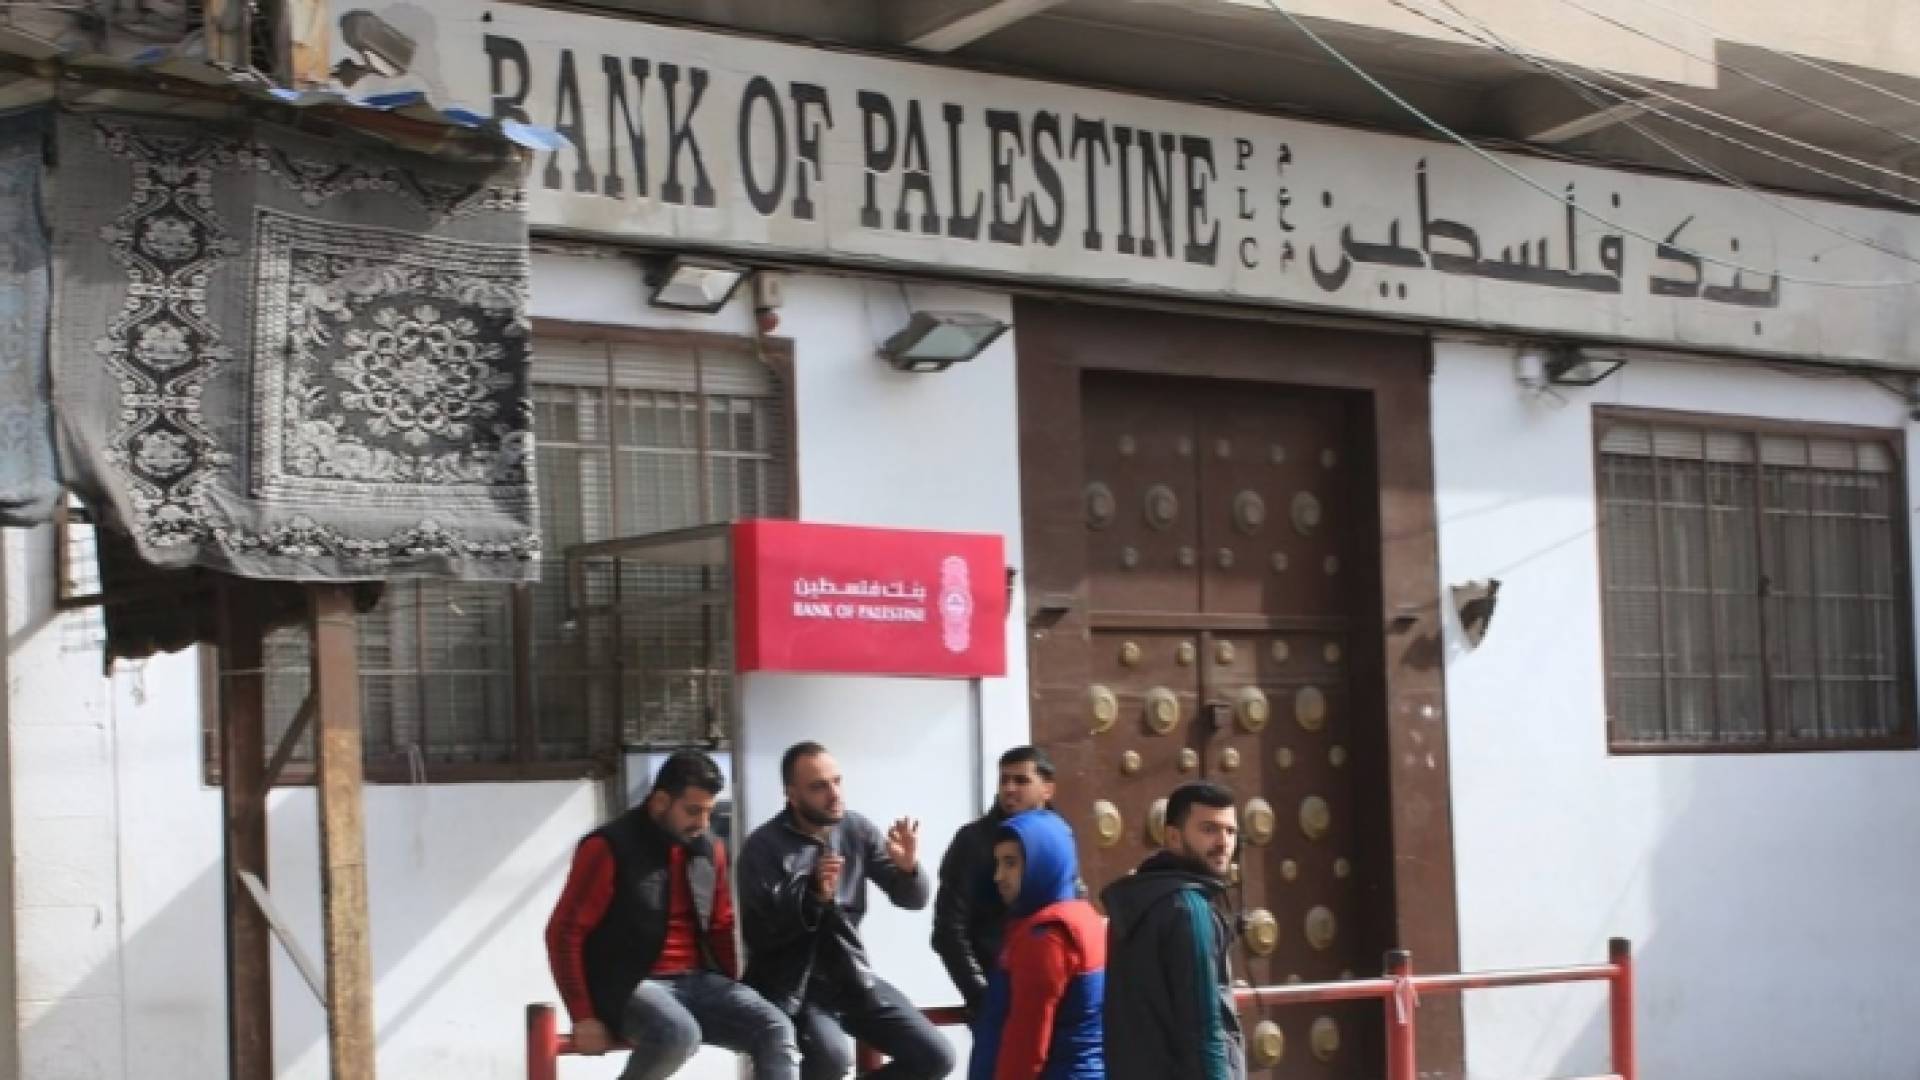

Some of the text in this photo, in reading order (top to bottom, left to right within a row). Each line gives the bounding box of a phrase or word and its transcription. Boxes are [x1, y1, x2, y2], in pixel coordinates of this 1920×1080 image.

[483, 33, 1221, 266] BANK OF PALESTINE
[1648, 215, 1780, 336] بنك
[793, 577, 927, 602] بنك فلسطين
[793, 600, 926, 622] BANK OF PALESTINE
